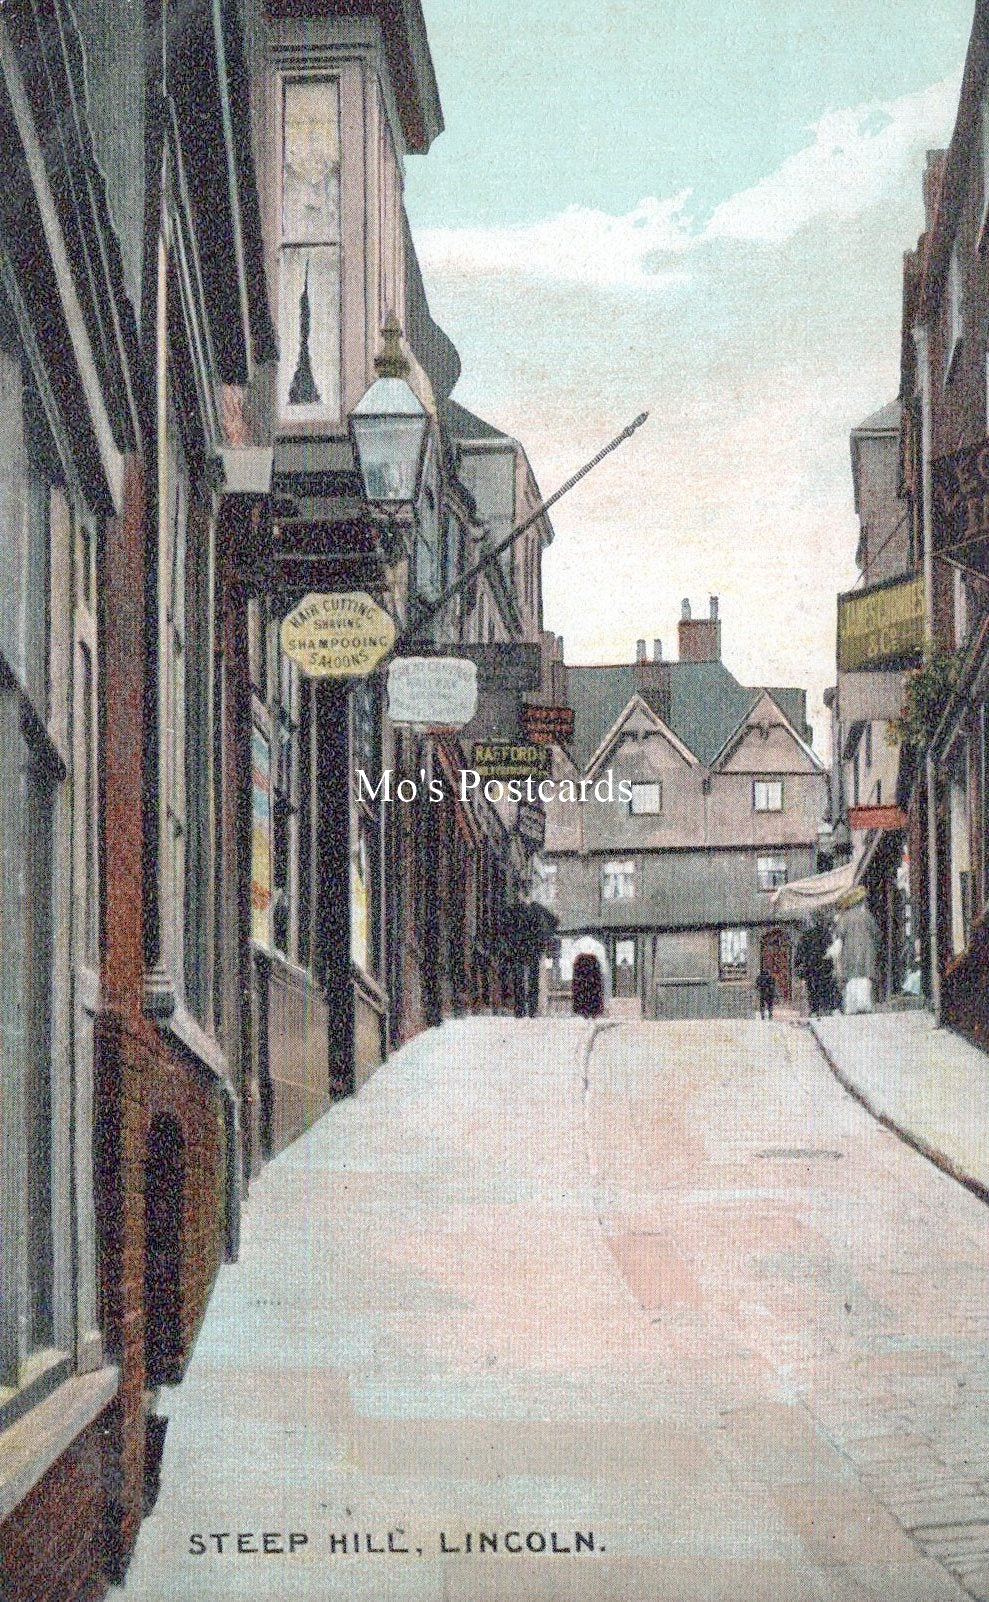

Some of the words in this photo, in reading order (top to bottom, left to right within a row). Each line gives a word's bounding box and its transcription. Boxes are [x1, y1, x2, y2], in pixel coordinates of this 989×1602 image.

[322, 598, 377, 620] CUTTING
[288, 635, 388, 650] SHAMPOOING
[309, 650, 369, 669] SALOONS
